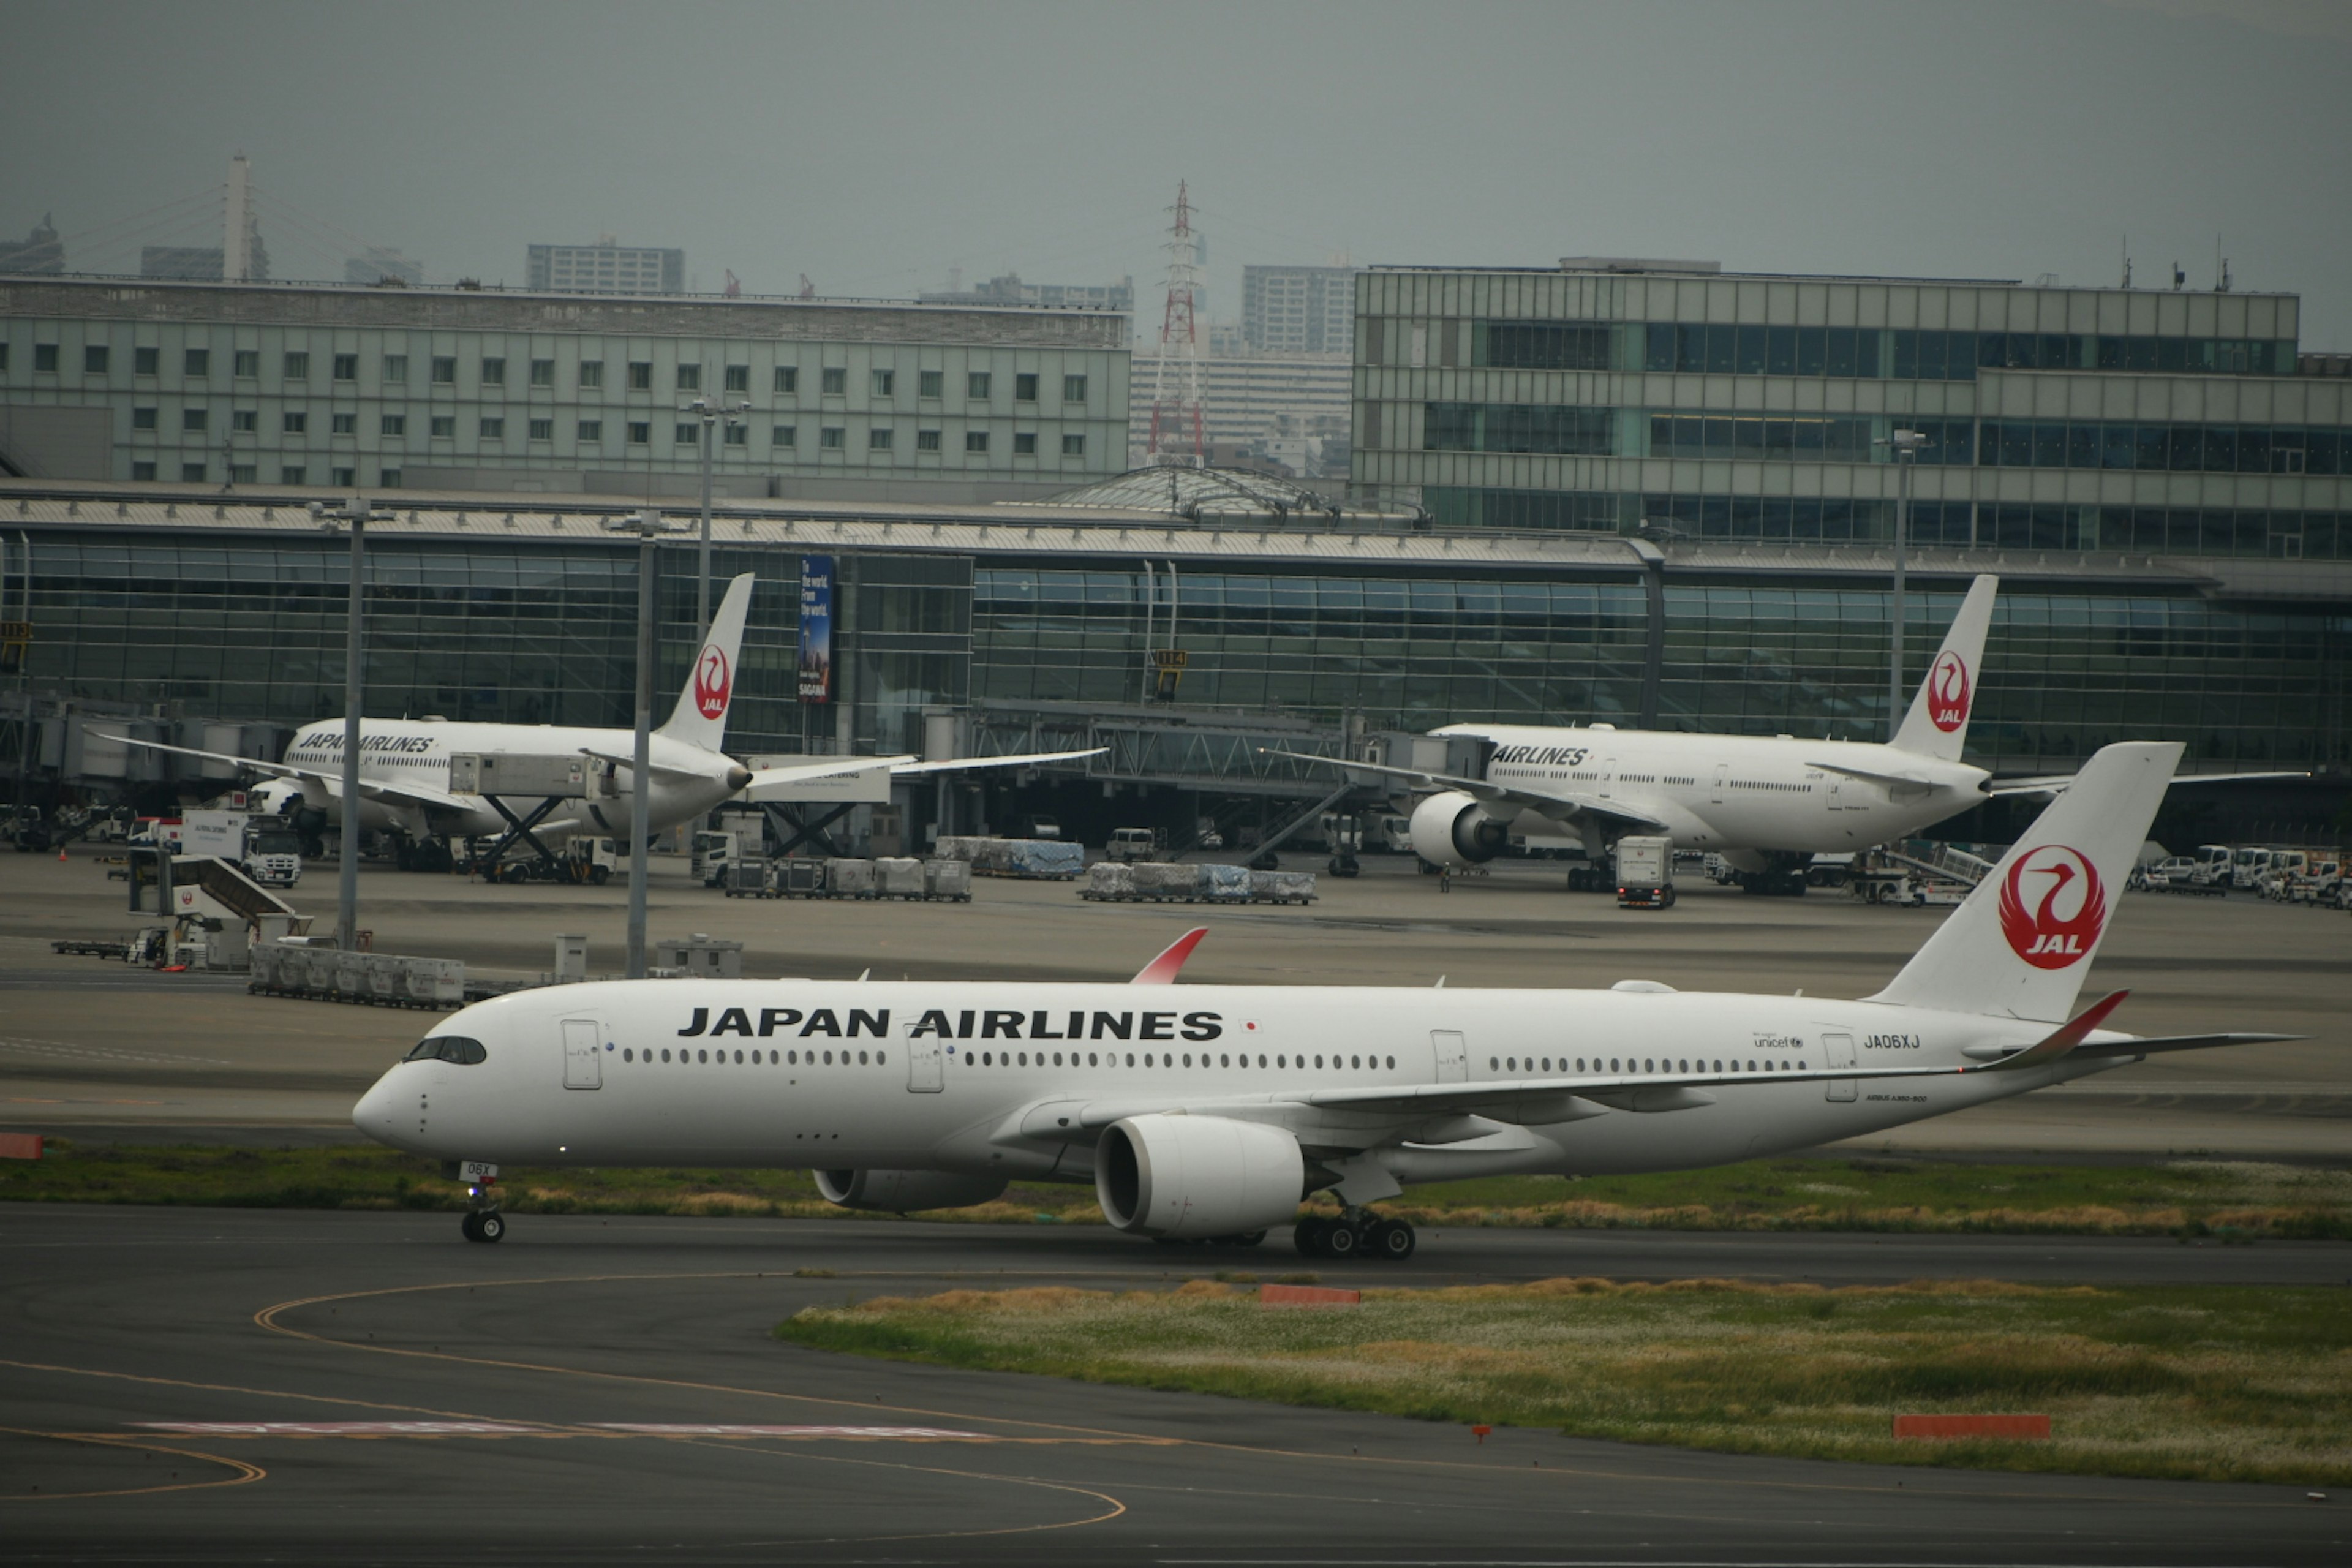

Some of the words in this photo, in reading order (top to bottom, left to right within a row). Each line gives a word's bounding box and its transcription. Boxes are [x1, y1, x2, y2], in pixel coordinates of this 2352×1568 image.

[1162, 652, 1183, 663] 114
[702, 698, 723, 711] JAL
[1936, 709, 1961, 723] JAL
[300, 733, 346, 750] JAPA
[358, 735, 434, 753] AIRLINES
[1491, 745, 1589, 766] AIRLINES
[2026, 935, 2082, 954] JAL
[677, 1008, 891, 1038] JAPAN
[910, 1010, 1224, 1041] AIRLINES
[1755, 1036, 1789, 1047] unicef
[1864, 1035, 1920, 1049] JA06XJ
[468, 1163, 490, 1175] 06X
